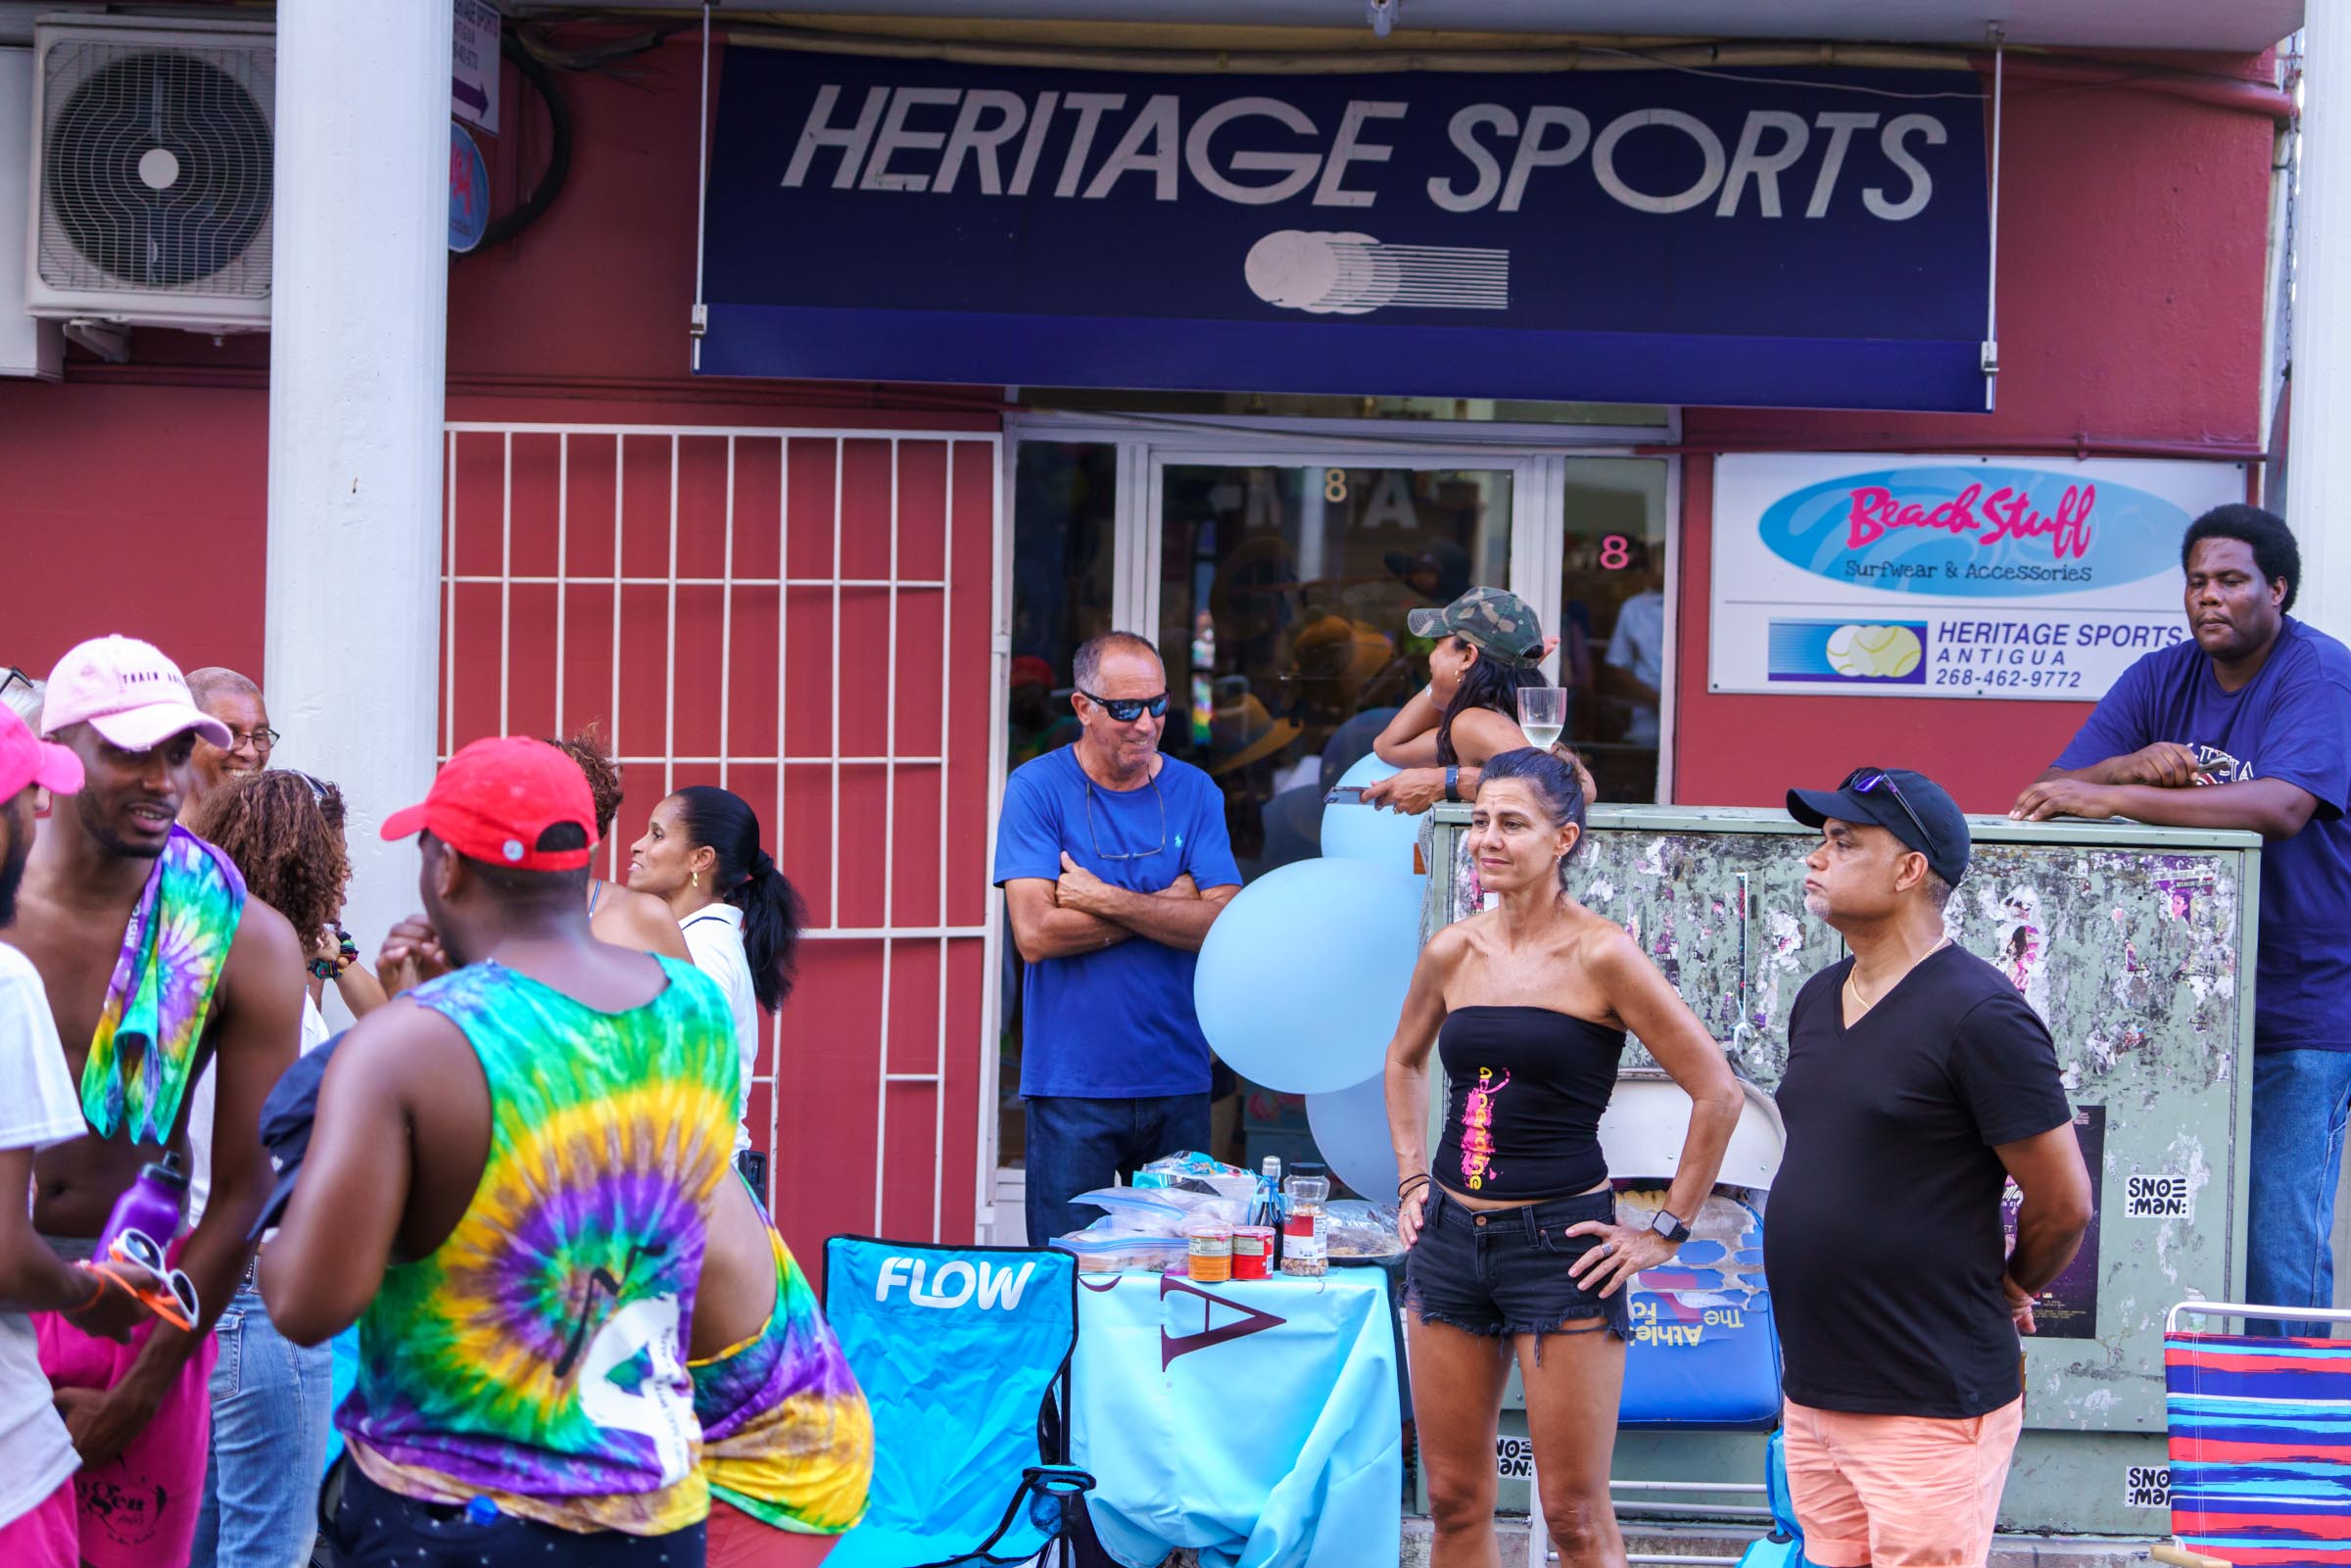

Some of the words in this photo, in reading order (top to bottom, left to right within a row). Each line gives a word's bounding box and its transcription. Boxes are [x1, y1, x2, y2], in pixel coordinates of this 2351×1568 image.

[781, 83, 1409, 208] HERITAGE
[1426, 103, 1948, 221] SPORTS
[1325, 468, 1348, 503] 8
[1847, 483, 1982, 549] Beach
[1979, 484, 2095, 559] Stuff
[1600, 535, 1630, 570] 8
[1846, 559, 1939, 579] Surfwear
[1945, 560, 1958, 579] &
[1965, 563, 2093, 582] Accessories
[1937, 622, 2071, 645] HERITAGE
[2076, 624, 2183, 647] SPORTS
[1936, 647, 2066, 666] ANTIGUA
[1936, 668, 2082, 688] 268-462-9772
[876, 1257, 1036, 1310] FLOW
[1704, 1308, 1745, 1329] The
[2129, 1468, 2172, 1488] SNO
